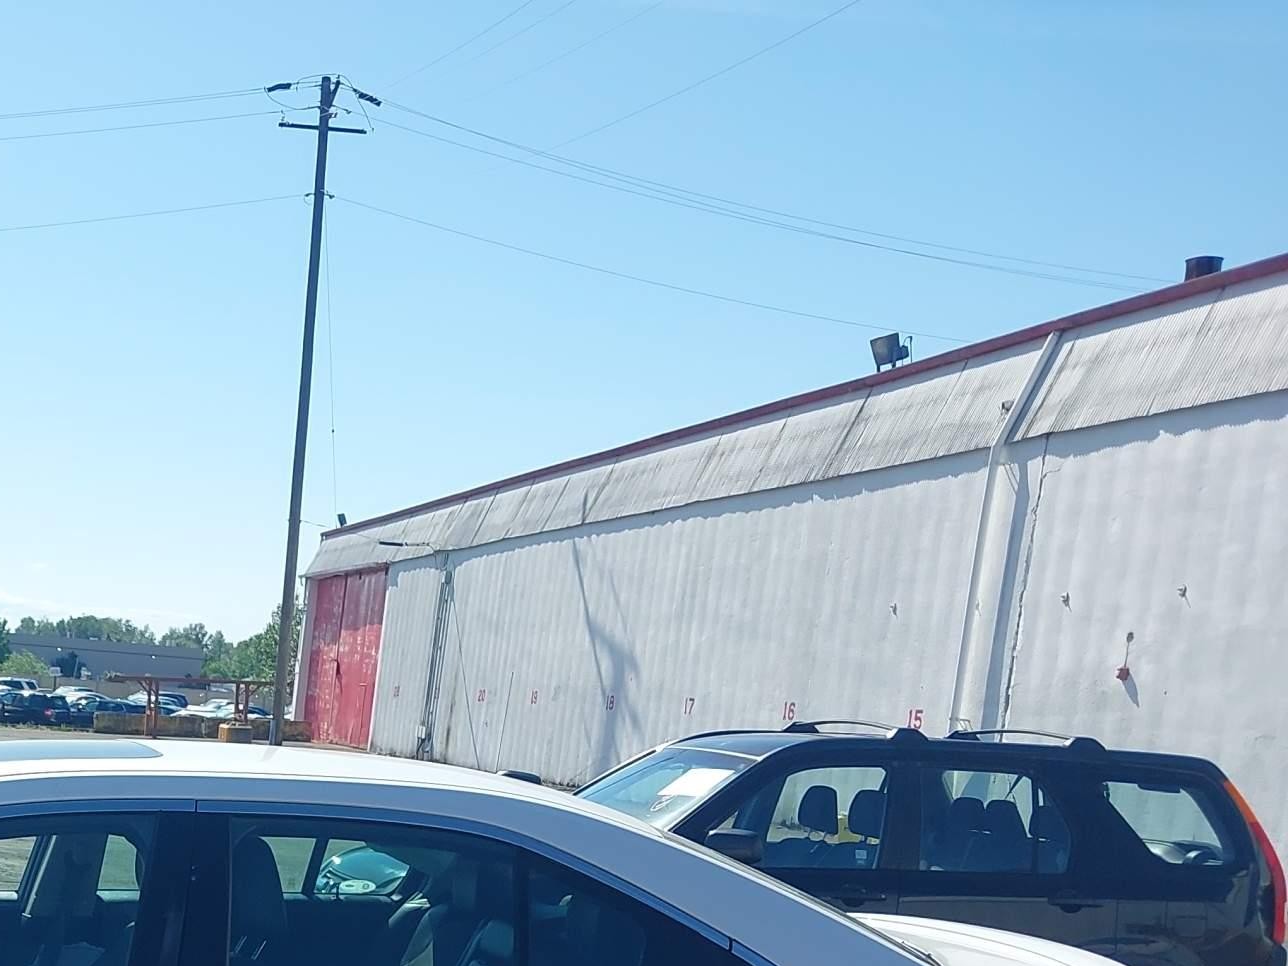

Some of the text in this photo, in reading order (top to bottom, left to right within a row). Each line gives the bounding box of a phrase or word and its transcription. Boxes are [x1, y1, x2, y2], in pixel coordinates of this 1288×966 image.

[477, 689, 486, 702] 20
[530, 689, 539, 705] 19
[605, 695, 615, 711] 18
[683, 697, 696, 716] 17
[782, 701, 796, 721] 16
[906, 709, 924, 729] 15
